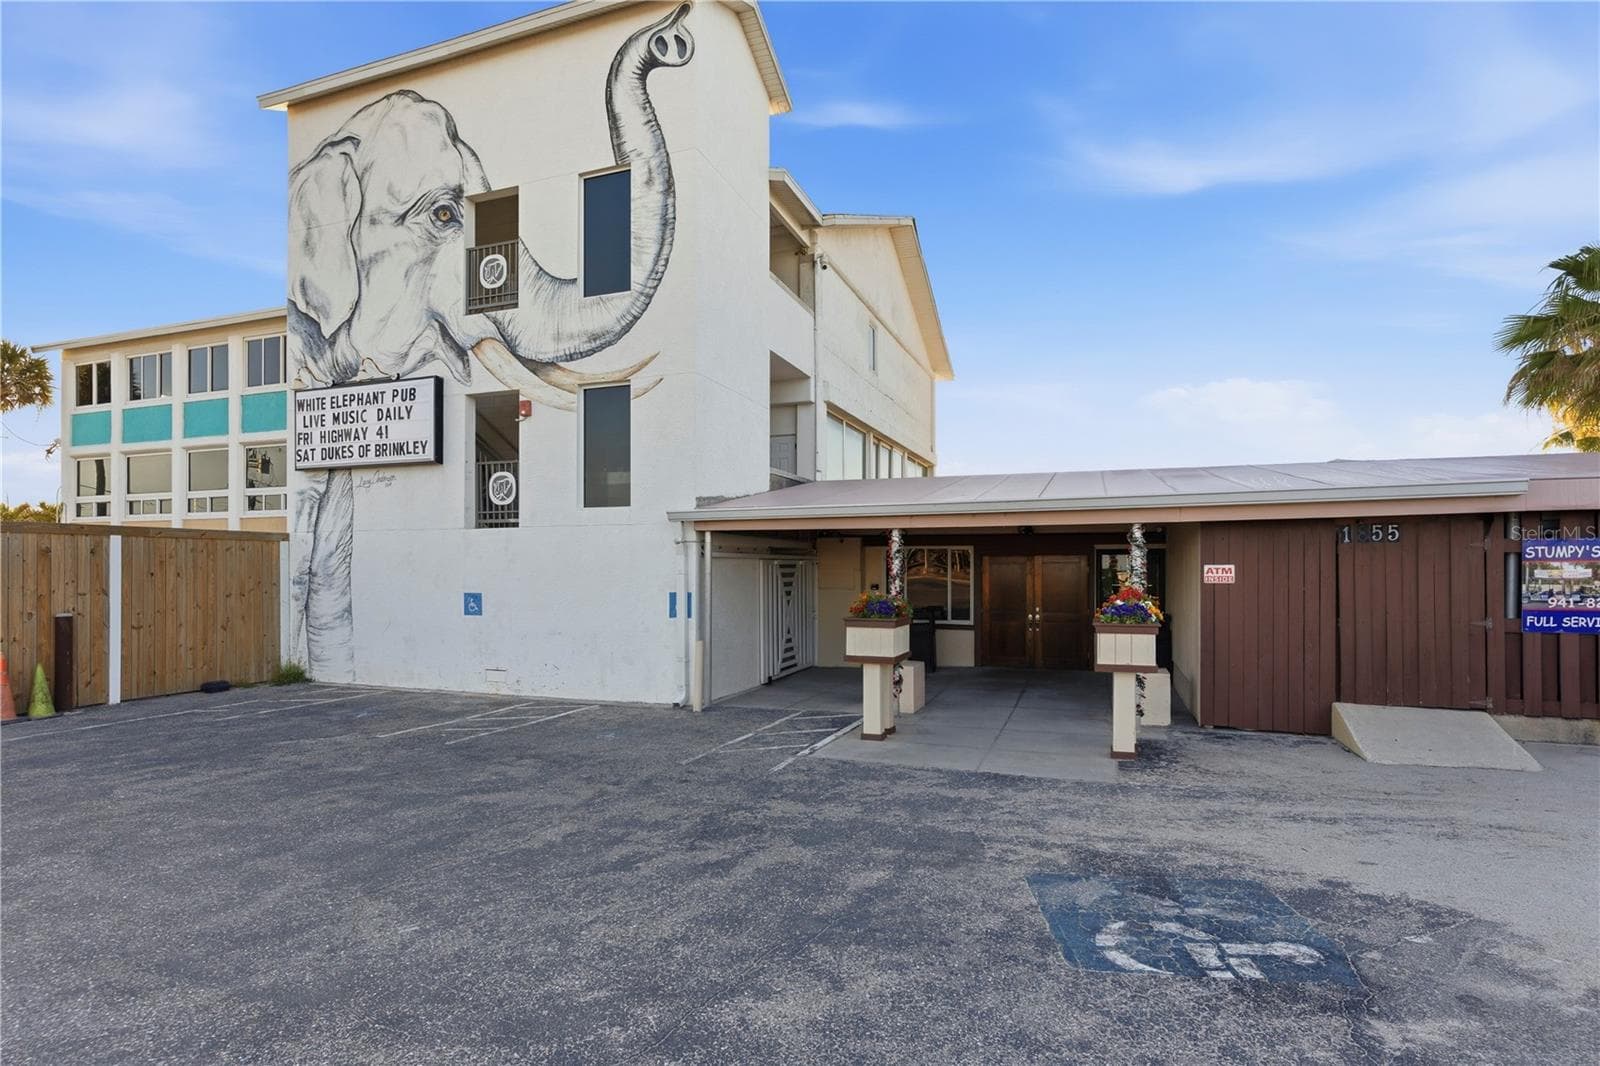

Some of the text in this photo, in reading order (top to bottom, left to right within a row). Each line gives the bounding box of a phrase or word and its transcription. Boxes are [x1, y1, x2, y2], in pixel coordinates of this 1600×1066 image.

[297, 388, 417, 412] WHITE ELEPHANT PUB
[303, 405, 413, 428] LIVE MUSIC DAILY
[297, 431, 313, 446] FRI
[320, 427, 368, 444] HIGHWAY
[296, 440, 428, 462] SAT DUKES OF BRINKLEY
[1342, 524, 1399, 543] 155
[1525, 545, 1600, 559] STUMPY'S
[1206, 567, 1232, 575] ATM
[1526, 616, 1557, 628] FULL
